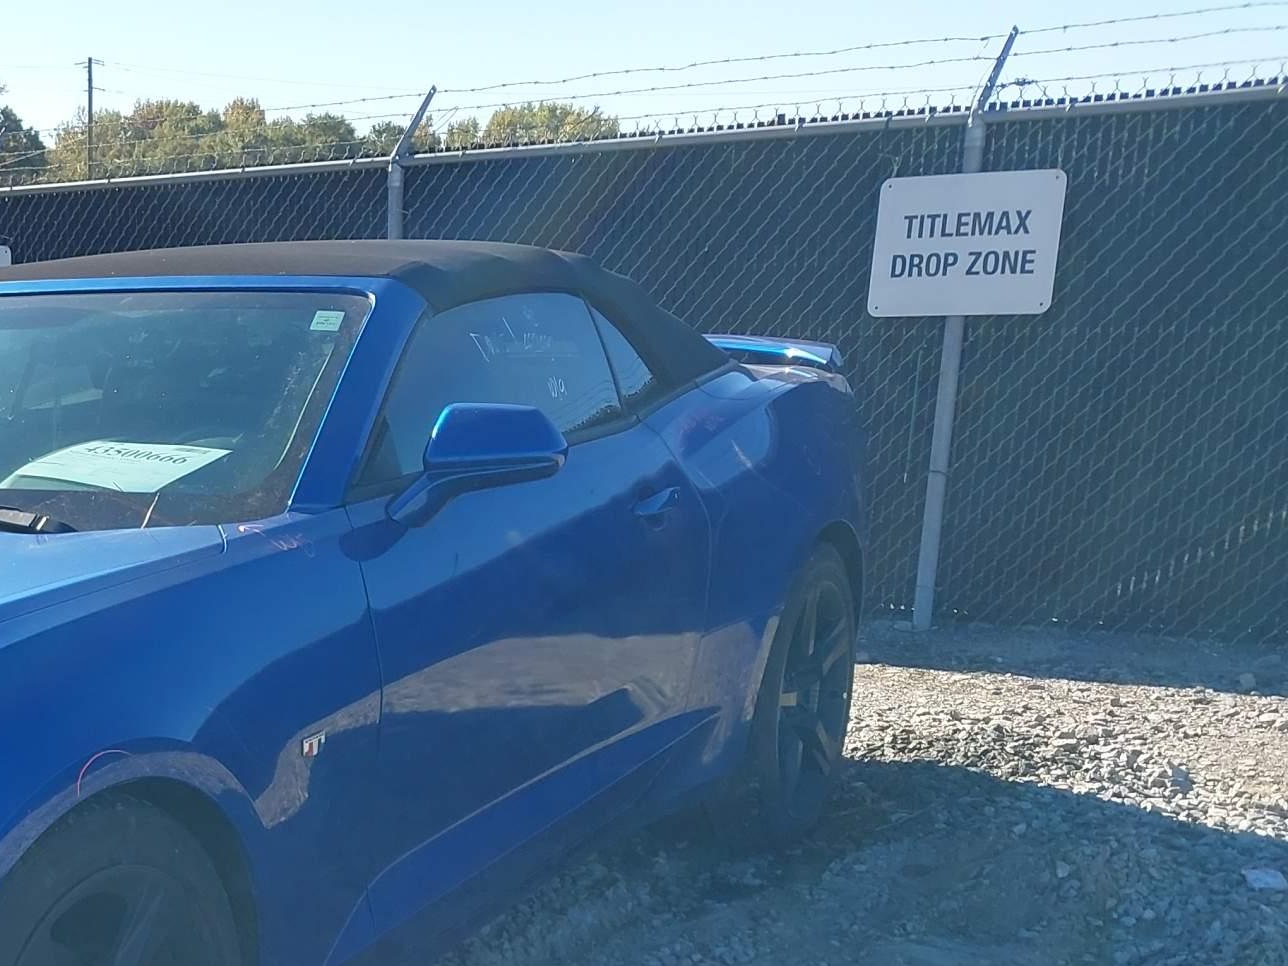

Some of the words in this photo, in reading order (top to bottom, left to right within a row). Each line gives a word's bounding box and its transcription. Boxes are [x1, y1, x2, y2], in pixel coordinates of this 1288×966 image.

[904, 210, 1032, 239] TITLEMAX
[890, 252, 959, 278] DROP
[965, 250, 1037, 276] ZONE
